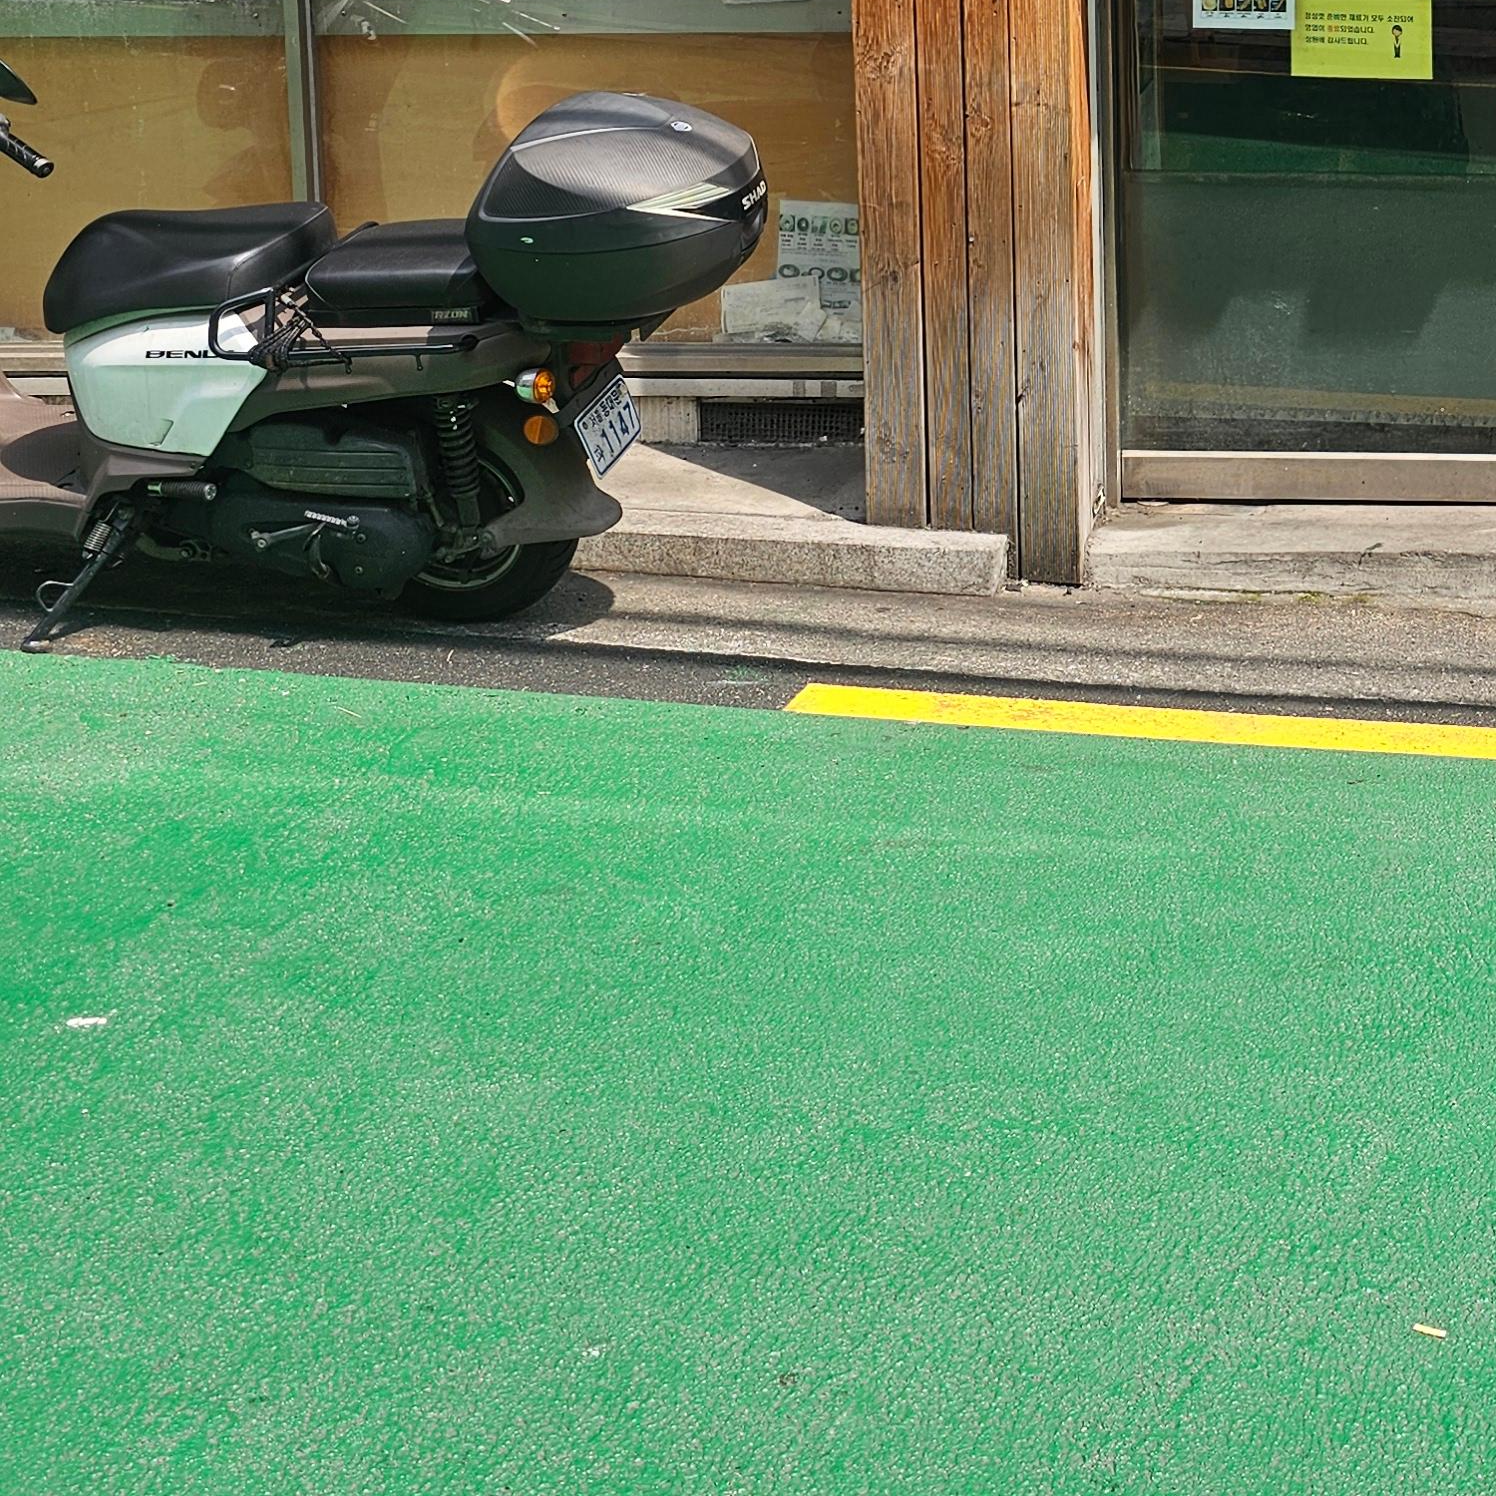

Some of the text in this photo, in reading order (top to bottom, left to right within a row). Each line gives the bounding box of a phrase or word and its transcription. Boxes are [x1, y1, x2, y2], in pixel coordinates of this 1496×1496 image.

[1371, 14, 1384, 22] 모두
[1387, 15, 1414, 23] 소진되어
[741, 180, 767, 211] SHAD
[146, 349, 220, 358] BENL
[600, 400, 635, 456] 1147
